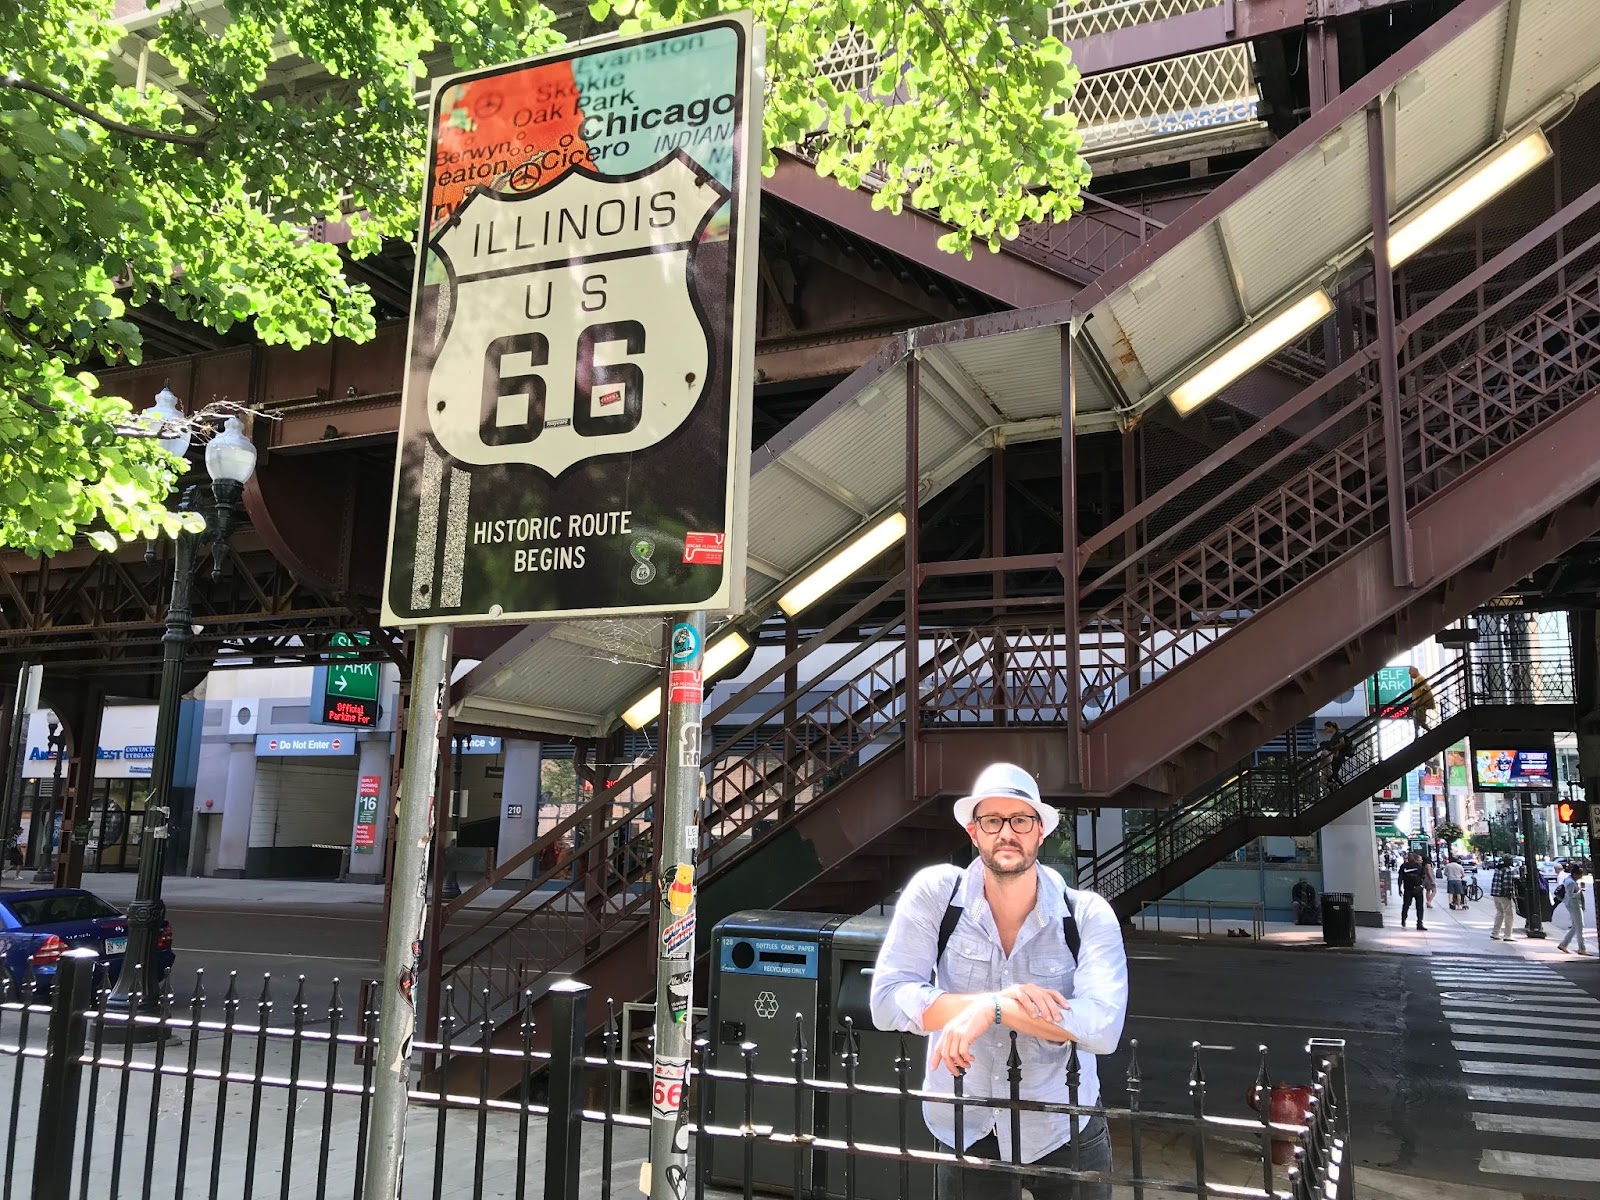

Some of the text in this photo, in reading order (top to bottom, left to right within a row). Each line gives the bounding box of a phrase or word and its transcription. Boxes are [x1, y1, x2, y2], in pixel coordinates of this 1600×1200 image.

[577, 33, 706, 74] Evanston
[536, 72, 625, 102] Skokie
[514, 88, 636, 128] Oak Park
[577, 94, 736, 141] Chicago
[436, 140, 510, 167] Berwyn
[540, 140, 631, 171] Cicero
[437, 160, 509, 187] eaton
[473, 191, 676, 258] ILLINOIS
[525, 274, 608, 320] U S
[479, 319, 646, 447] 66
[473, 511, 632, 545] HISTORIC ROUTE
[514, 546, 586, 573] BEGINS
[329, 710, 371, 724] Parking For
[337, 702, 365, 715] Official
[280, 740, 330, 750] Do Not Enter
[360, 796, 377, 810] $16
[763, 965, 807, 975] RECYCLING ONLY
